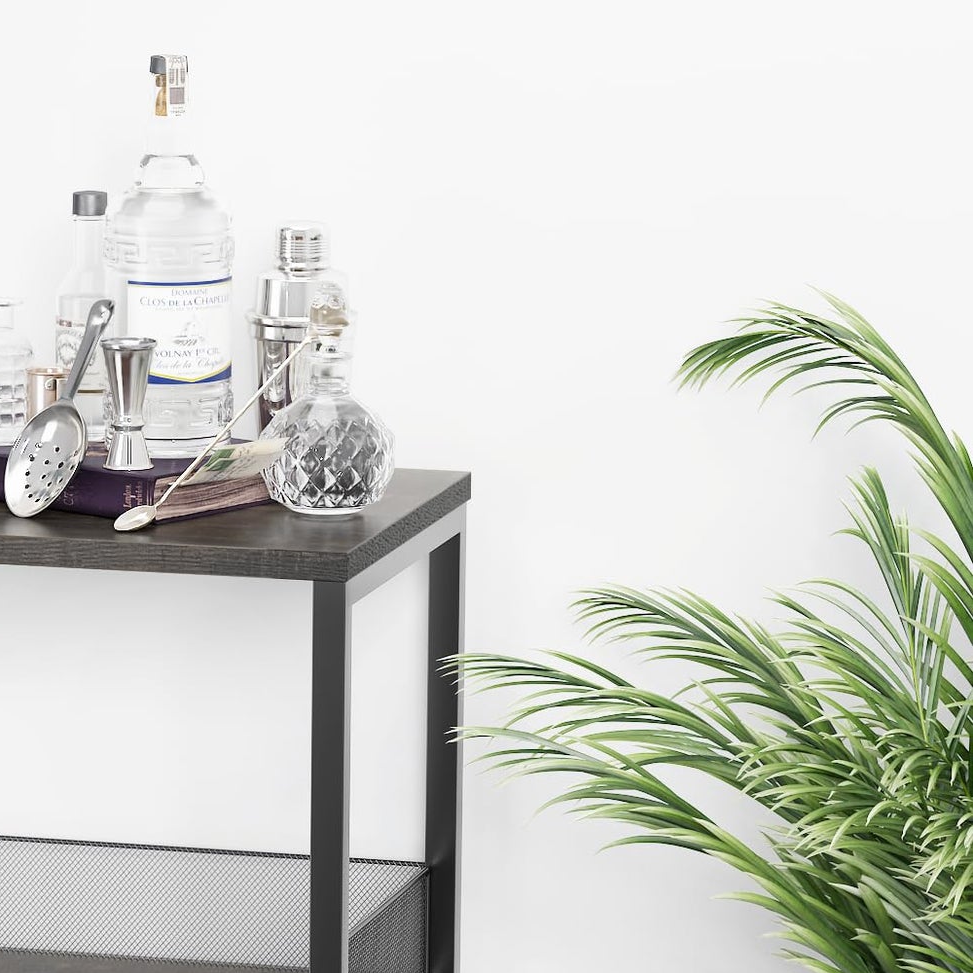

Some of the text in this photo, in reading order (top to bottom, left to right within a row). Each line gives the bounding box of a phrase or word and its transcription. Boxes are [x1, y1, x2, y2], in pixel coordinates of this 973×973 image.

[171, 288, 209, 297] DOMAINE
[139, 296, 166, 306] CLOS
[168, 299, 180, 307] DE
[183, 299, 193, 307] LA
[154, 350, 192, 358] VOLNAY
